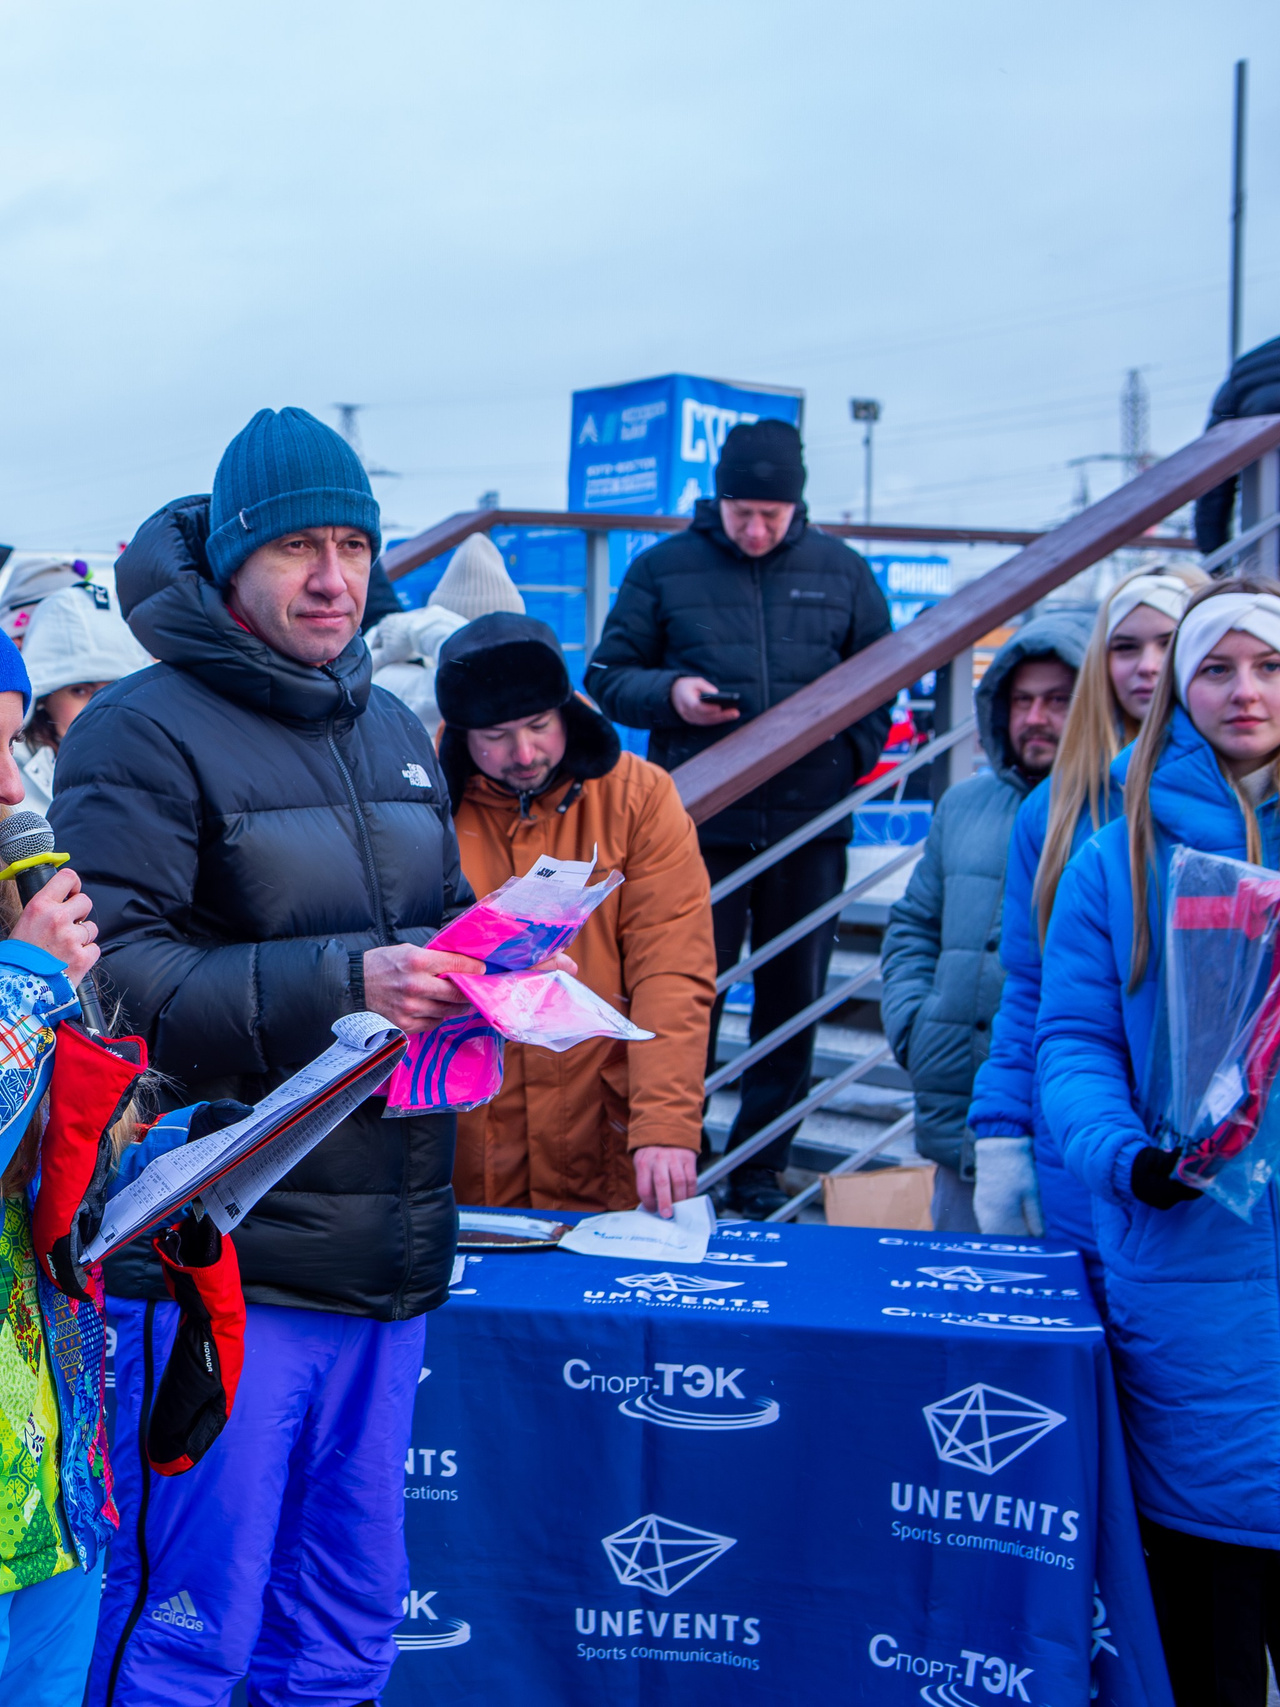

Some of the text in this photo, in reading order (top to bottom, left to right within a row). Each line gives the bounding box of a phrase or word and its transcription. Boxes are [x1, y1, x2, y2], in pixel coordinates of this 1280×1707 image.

[583, 1290, 770, 1308] UNEVENTS
[890, 1280, 1079, 1296] UNEVENTS
[891, 1481, 1080, 1542] UNEVENTS
[891, 1520, 1075, 1570] Sports communications
[151, 1610, 204, 1632] adidas
[575, 1607, 761, 1646] UNEVENTS
[577, 1642, 760, 1671] Sports communications
